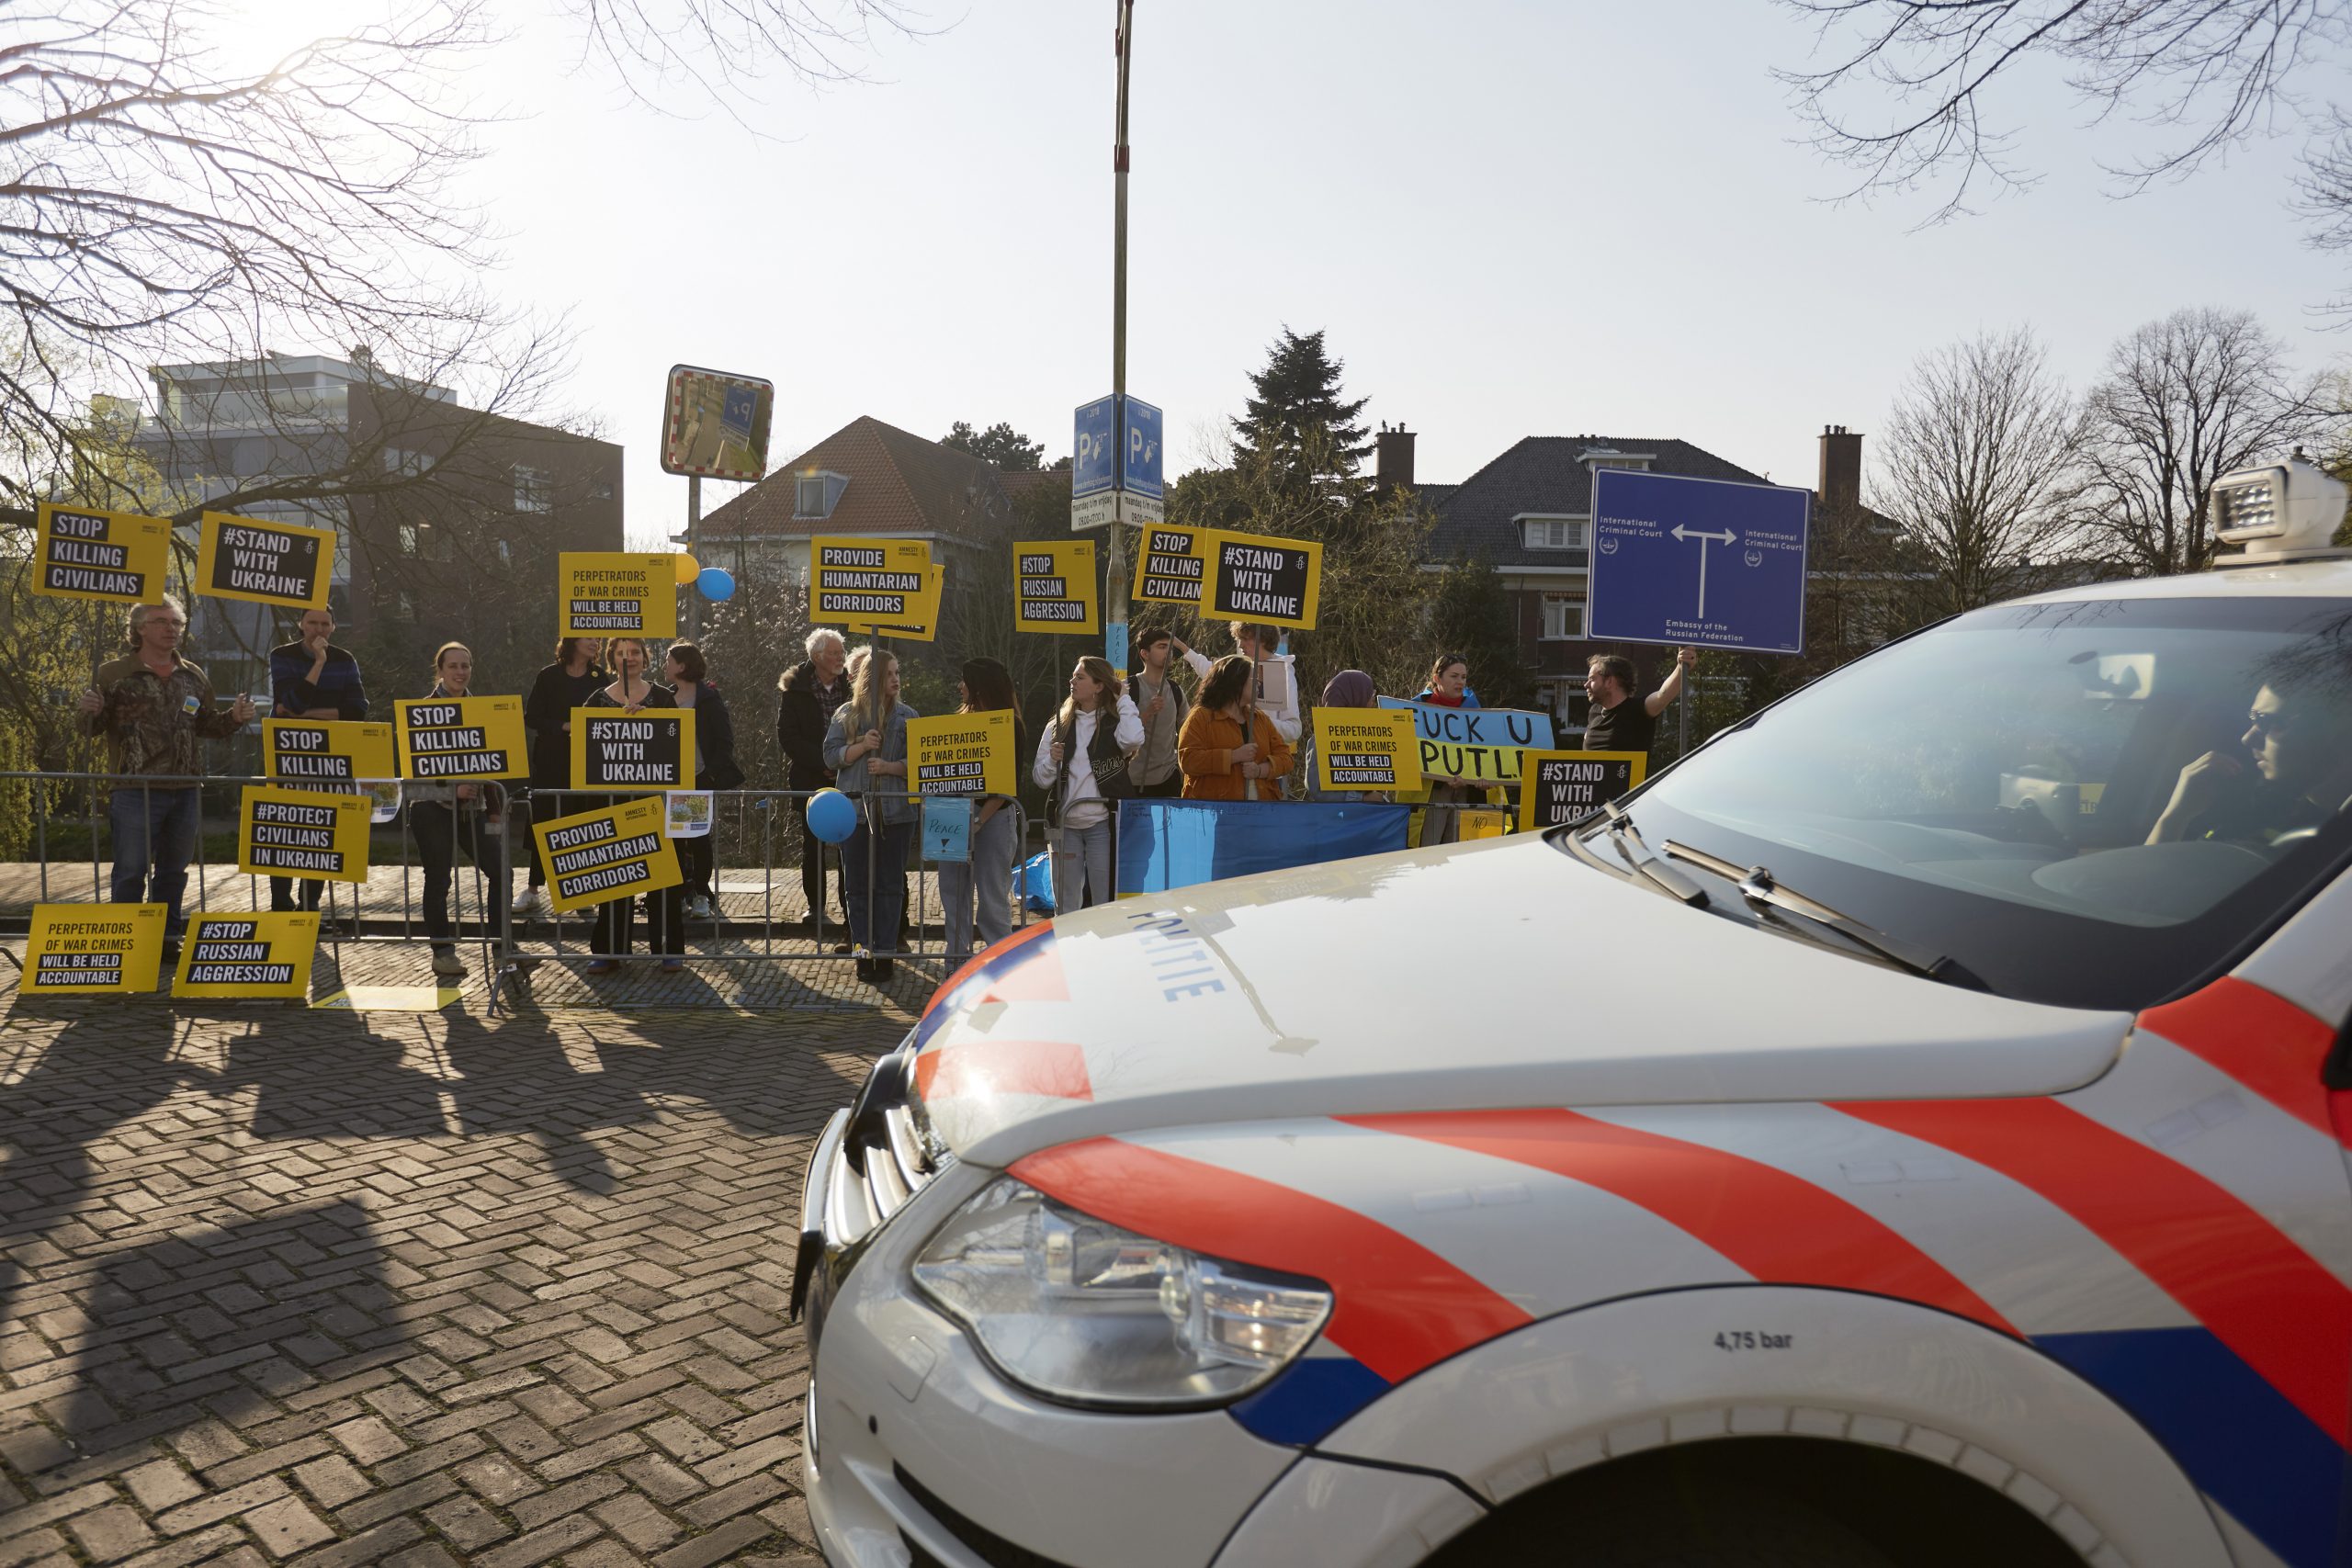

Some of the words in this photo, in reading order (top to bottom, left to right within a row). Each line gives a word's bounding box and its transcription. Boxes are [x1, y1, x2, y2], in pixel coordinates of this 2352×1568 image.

[1079, 433, 1091, 470] P
[1130, 427, 1143, 464] P
[56, 514, 104, 537] STOP
[1600, 516, 1657, 528] International
[223, 527, 291, 554] #STAND
[1600, 525, 1637, 536] Criminal
[1638, 528, 1663, 538] Court
[1746, 529, 1797, 542] International
[1154, 534, 1189, 552] STOP
[1745, 539, 1779, 549] Criminal
[1781, 542, 1803, 552] Court
[53, 541, 123, 567] KILLING
[233, 549, 278, 572] WITH
[824, 549, 883, 567] PROVIDE
[1224, 547, 1283, 570] #STAND
[1023, 557, 1051, 573] #STOP
[1150, 557, 1201, 577] KILLING
[51, 569, 138, 594] CIVILIANS
[231, 570, 307, 596] UKRAINE
[573, 570, 647, 582] PERPETRATORS
[823, 571, 918, 591] HUMANTARIAN
[1232, 570, 1273, 592] WITH
[573, 586, 585, 597] OF
[588, 586, 609, 597] WAR
[612, 586, 650, 598] CRIMES
[1023, 580, 1063, 596] RUSSIAN
[1147, 580, 1203, 599] CIVILIAN
[572, 601, 596, 613] WILL
[599, 602, 611, 613] BE
[614, 601, 639, 613] HELD
[822, 594, 902, 613] CORRIDORS
[1023, 602, 1083, 620] AGGRESSION
[1230, 591, 1298, 615] UKRAINE
[572, 616, 641, 628] ACCOUNTABLE
[1666, 619, 1702, 631] Embassy
[1704, 622, 1713, 631] of
[1714, 623, 1728, 632] the
[1666, 629, 1699, 638] Russian
[1702, 631, 1744, 642] Federation
[413, 706, 457, 726] STOP
[592, 722, 653, 740] #STAND
[1329, 725, 1393, 738] PERPETRATORS
[1507, 715, 1532, 745] U
[279, 730, 322, 750] STOP
[415, 729, 481, 750] KILLING
[921, 731, 988, 748] PERPETRATORS
[1330, 740, 1340, 750] OF
[1342, 741, 1363, 751] WAR
[1364, 741, 1397, 752] CRIMES
[602, 743, 644, 761] WITH
[921, 751, 931, 763] OF
[934, 750, 954, 761] WAR
[956, 747, 991, 761] CRIMES
[1331, 755, 1353, 766] WILL
[1355, 756, 1366, 766] BE
[1368, 756, 1390, 767] HELD
[281, 757, 347, 776] KILLING
[418, 753, 503, 775] CIVILIANS
[603, 763, 673, 782] UKRAINE
[921, 766, 942, 778] WILL
[944, 764, 956, 776] BE
[958, 762, 981, 775] HELD
[1543, 762, 1604, 782] #STAND
[1333, 770, 1394, 783] ACCOUNTABLE
[922, 778, 984, 794] ACCOUNTABLE
[1552, 784, 1593, 802] WITH
[257, 804, 334, 826] #PROTECT
[625, 807, 647, 817] AMNESTY
[1550, 805, 1599, 823] UKRA
[928, 818, 964, 835] PEACE
[1471, 816, 1488, 830] NO
[256, 826, 329, 848] CIVILIANS
[549, 820, 615, 850] PROVIDE
[255, 849, 271, 865] IN
[276, 851, 339, 871] UKRAINE
[556, 835, 659, 873] HUMANTARIAN
[561, 863, 648, 897] CORRIDORS
[48, 922, 133, 935] PERPETRATORS
[202, 922, 253, 940] #STOP
[45, 939, 62, 952] OF
[63, 939, 88, 952] WAR
[91, 939, 134, 951] CRIMES
[197, 943, 265, 961] RUSSIAN
[41, 955, 71, 967] WILL
[73, 955, 88, 967] BE
[90, 954, 120, 967] HELD
[1127, 911, 1226, 1002] POLITIE
[38, 970, 120, 985] ACCOUNTABLE
[191, 965, 290, 982] AGGRESSION
[1713, 1331, 1756, 1353] 4,75
[1758, 1331, 1792, 1349] bar
